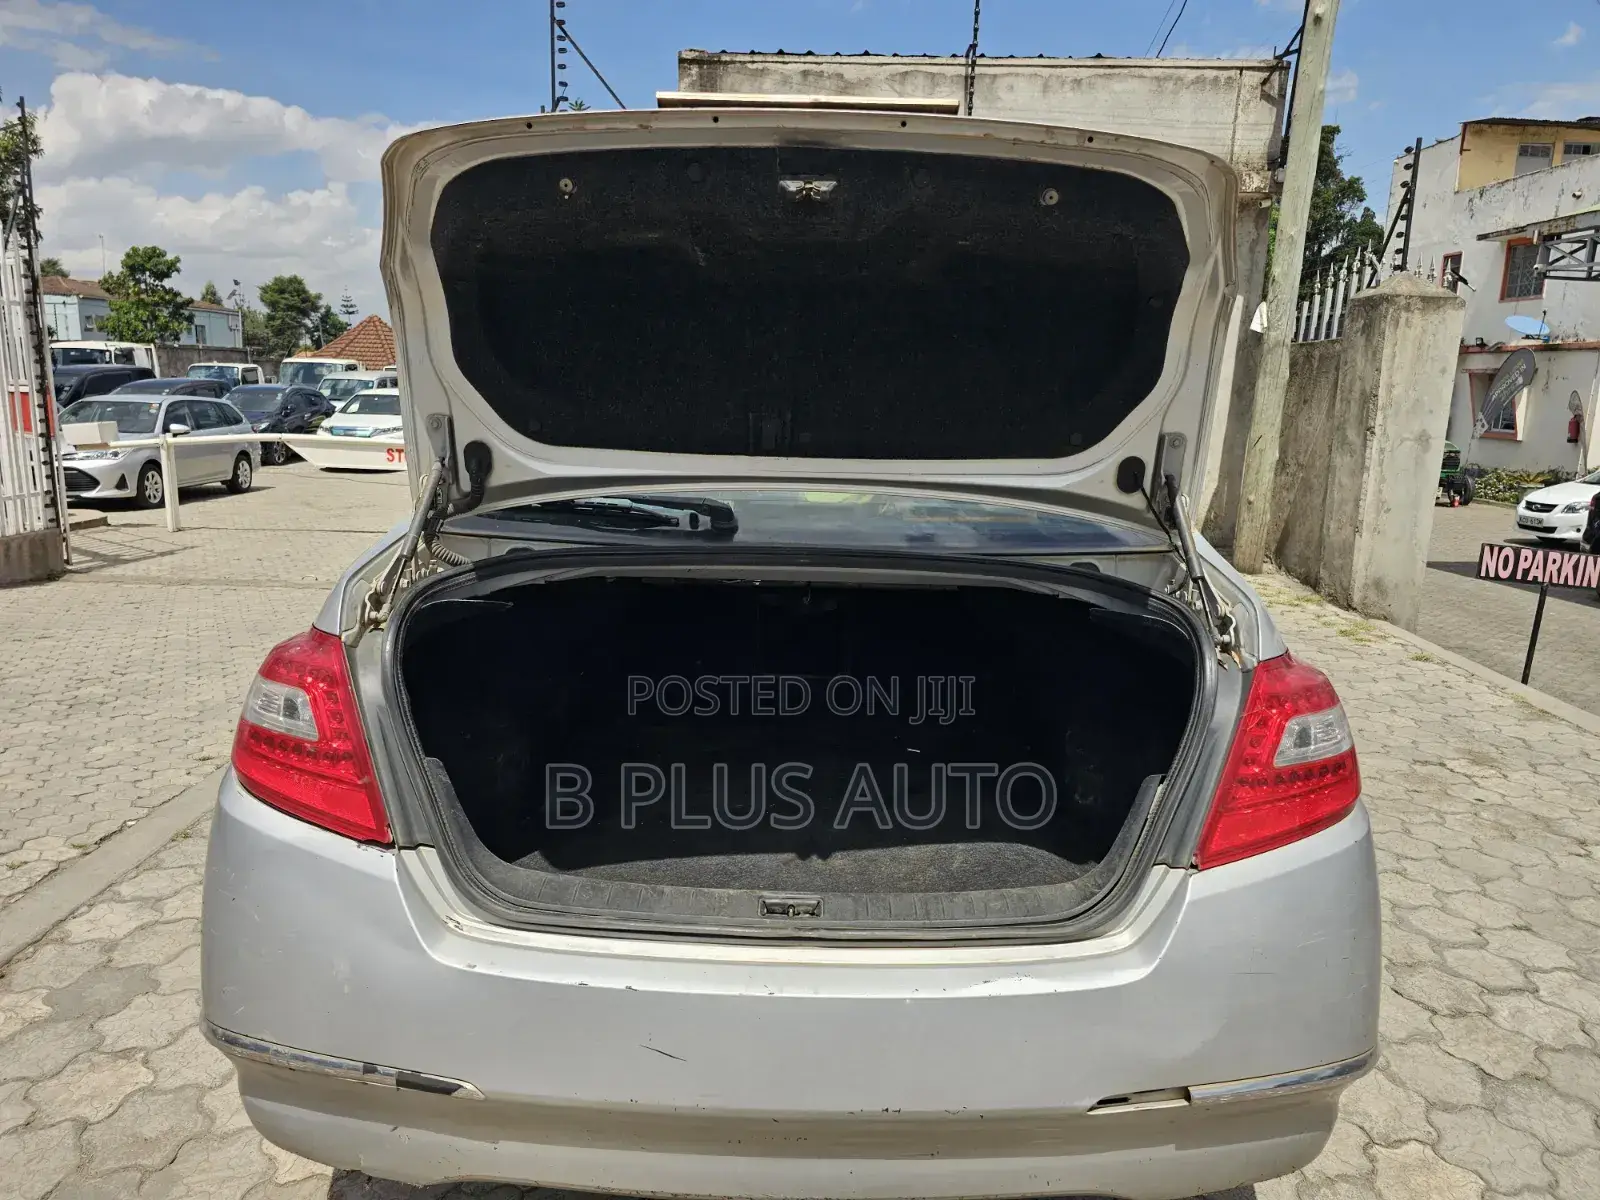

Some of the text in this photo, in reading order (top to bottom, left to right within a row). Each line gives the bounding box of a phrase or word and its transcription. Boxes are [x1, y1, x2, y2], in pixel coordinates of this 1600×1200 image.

[386, 447, 406, 463] ST
[1480, 545, 1600, 588] NO PARKIN
